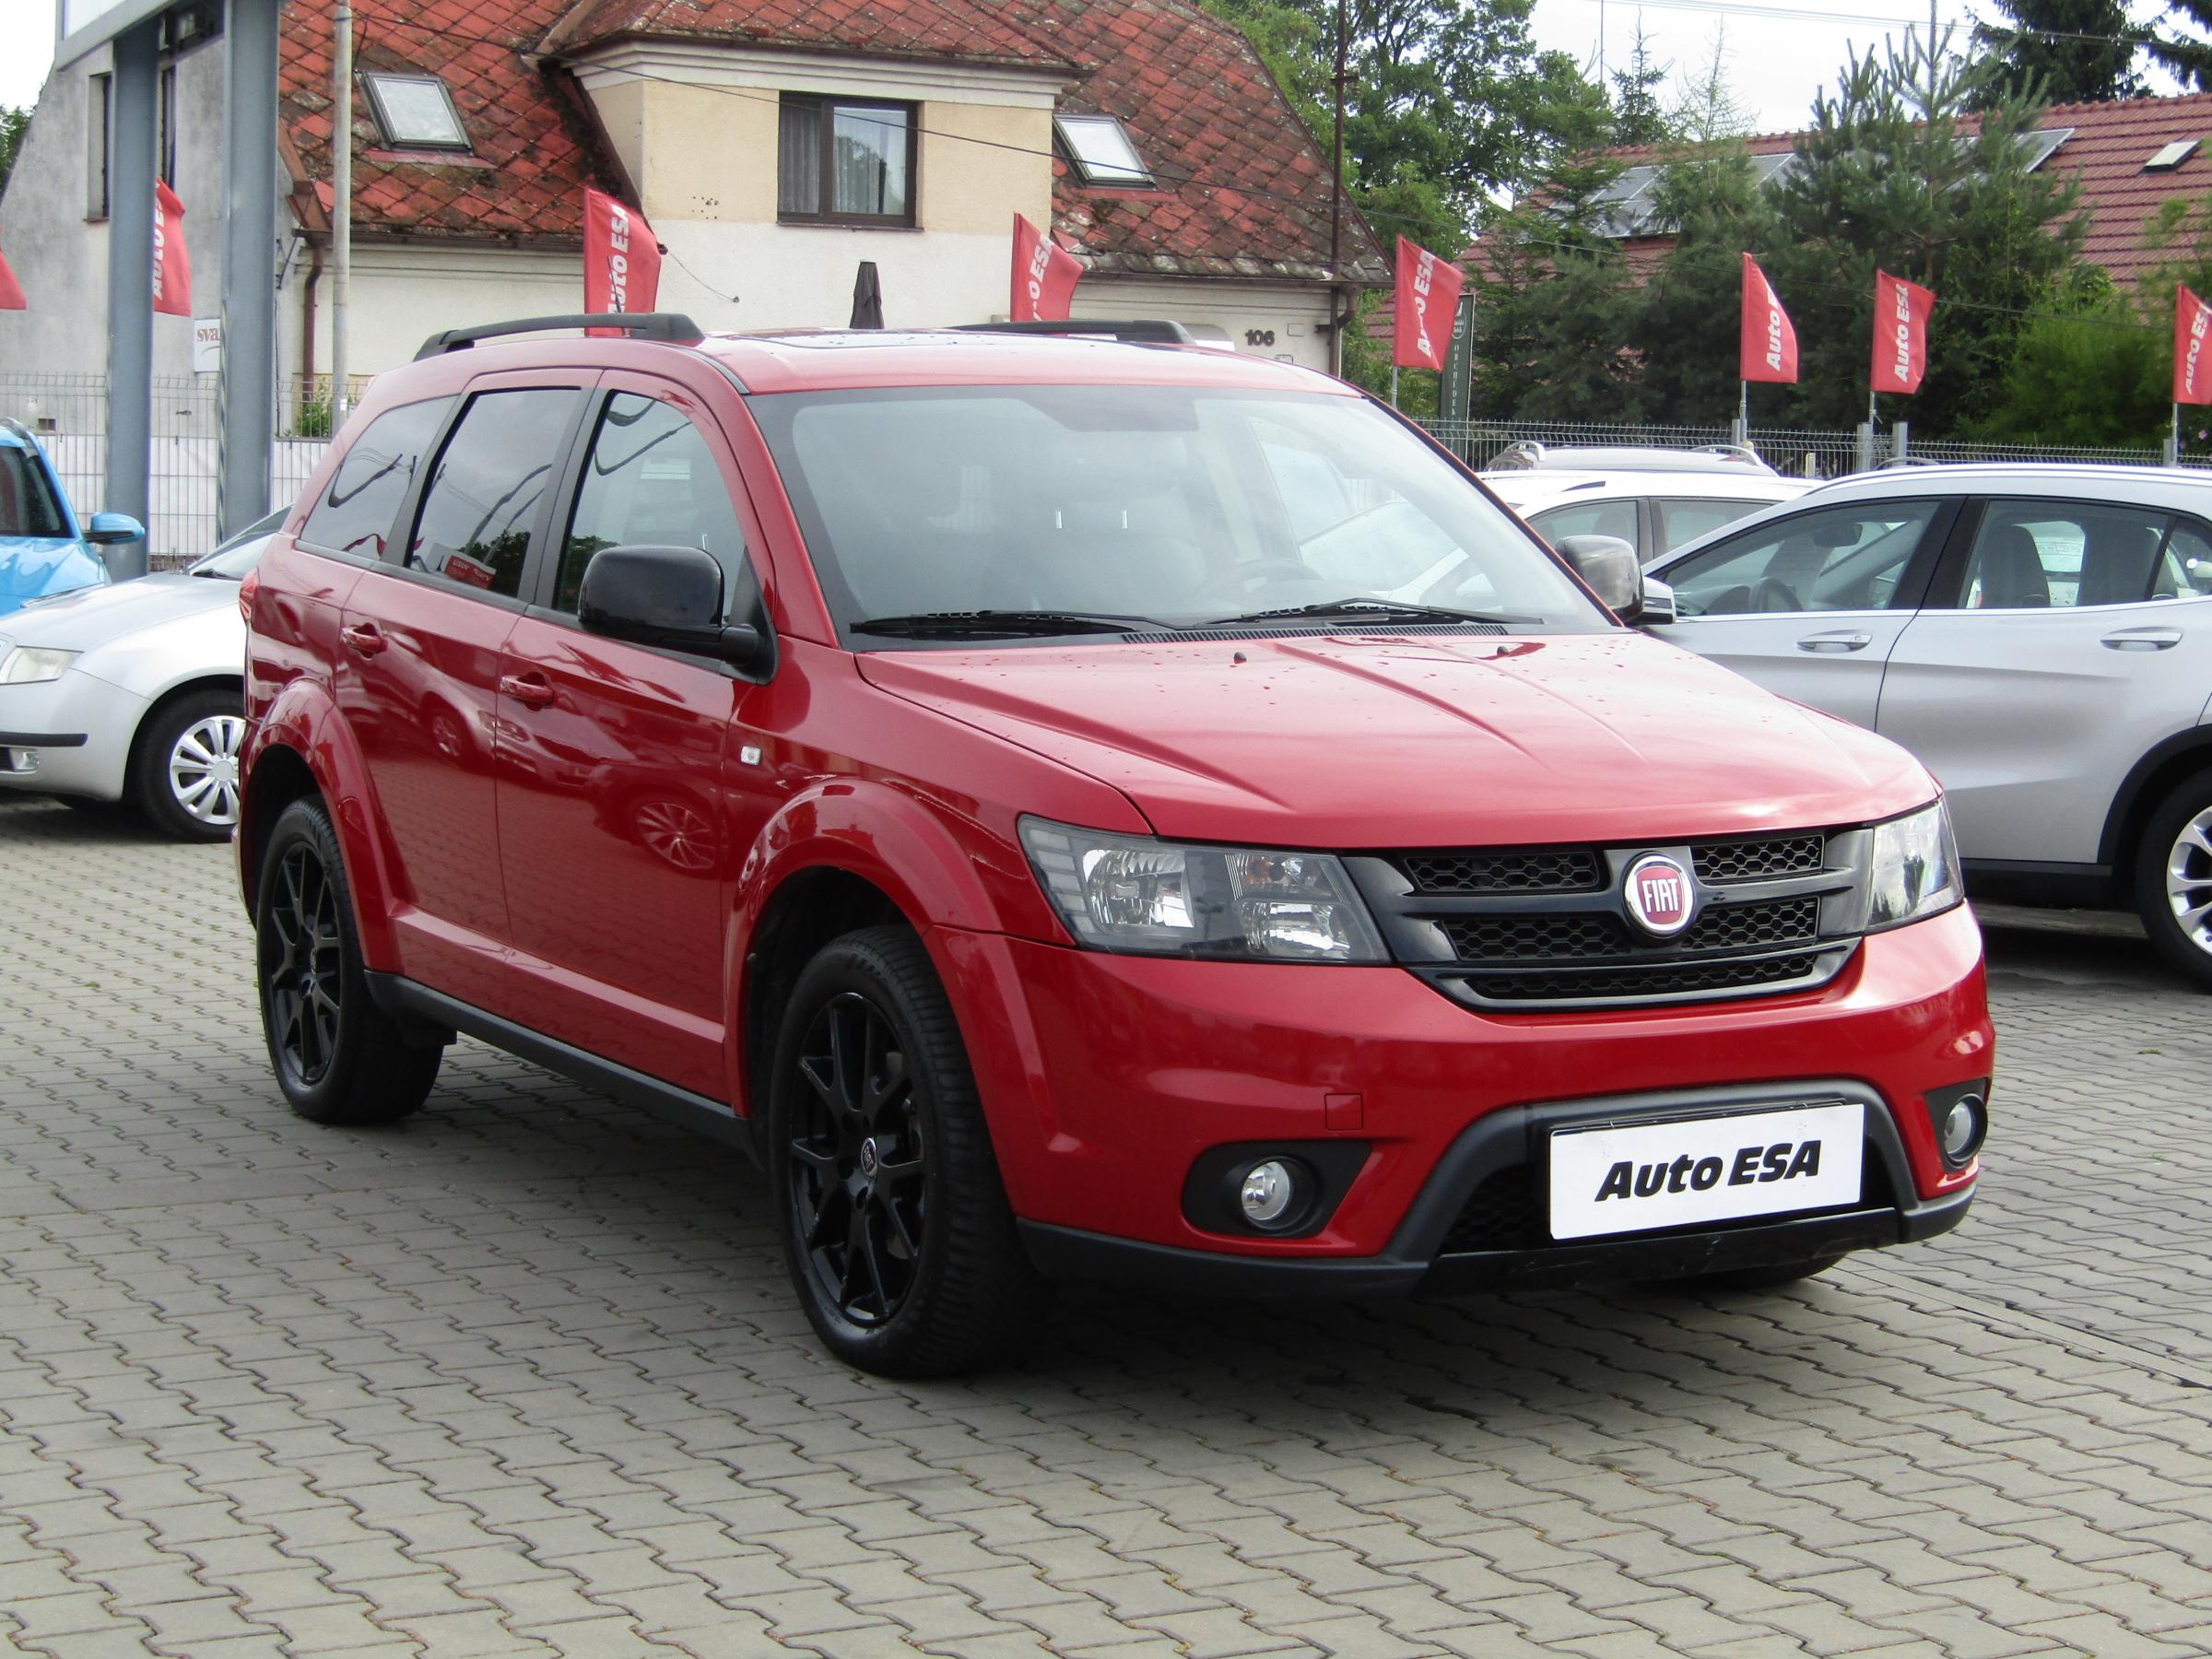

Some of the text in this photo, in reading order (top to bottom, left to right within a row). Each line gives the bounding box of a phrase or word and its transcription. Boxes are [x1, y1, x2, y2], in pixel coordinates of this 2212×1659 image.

[1244, 329, 1276, 347] 106
[1766, 310, 1782, 371] Auto
[1894, 324, 1910, 383] Auto
[1641, 878, 1678, 913] FIAT
[1594, 1139, 1821, 1203] Auto ESA
